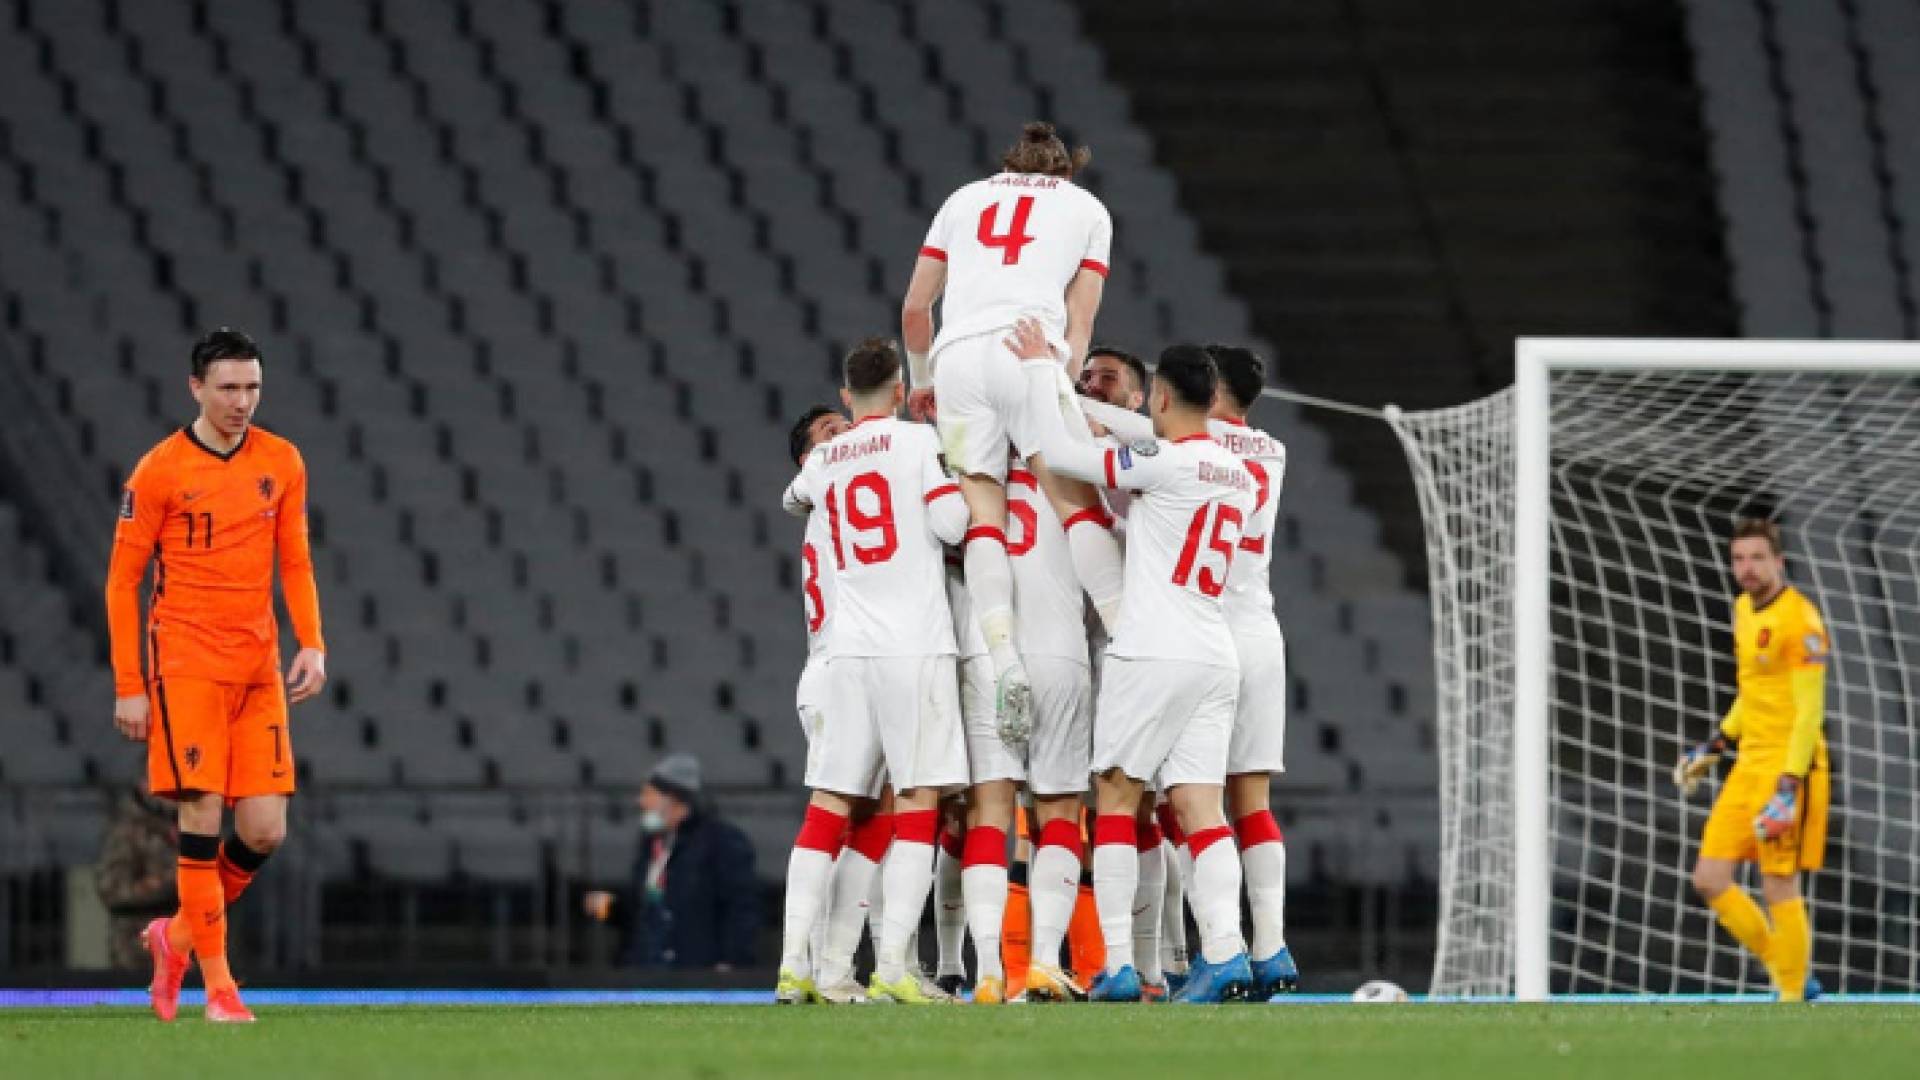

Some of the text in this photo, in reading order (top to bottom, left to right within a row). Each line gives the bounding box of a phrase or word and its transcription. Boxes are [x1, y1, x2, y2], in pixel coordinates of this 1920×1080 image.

[977, 195, 1036, 265] 4
[179, 512, 212, 549] 11
[826, 471, 898, 571] 19
[1172, 500, 1243, 597] 15
